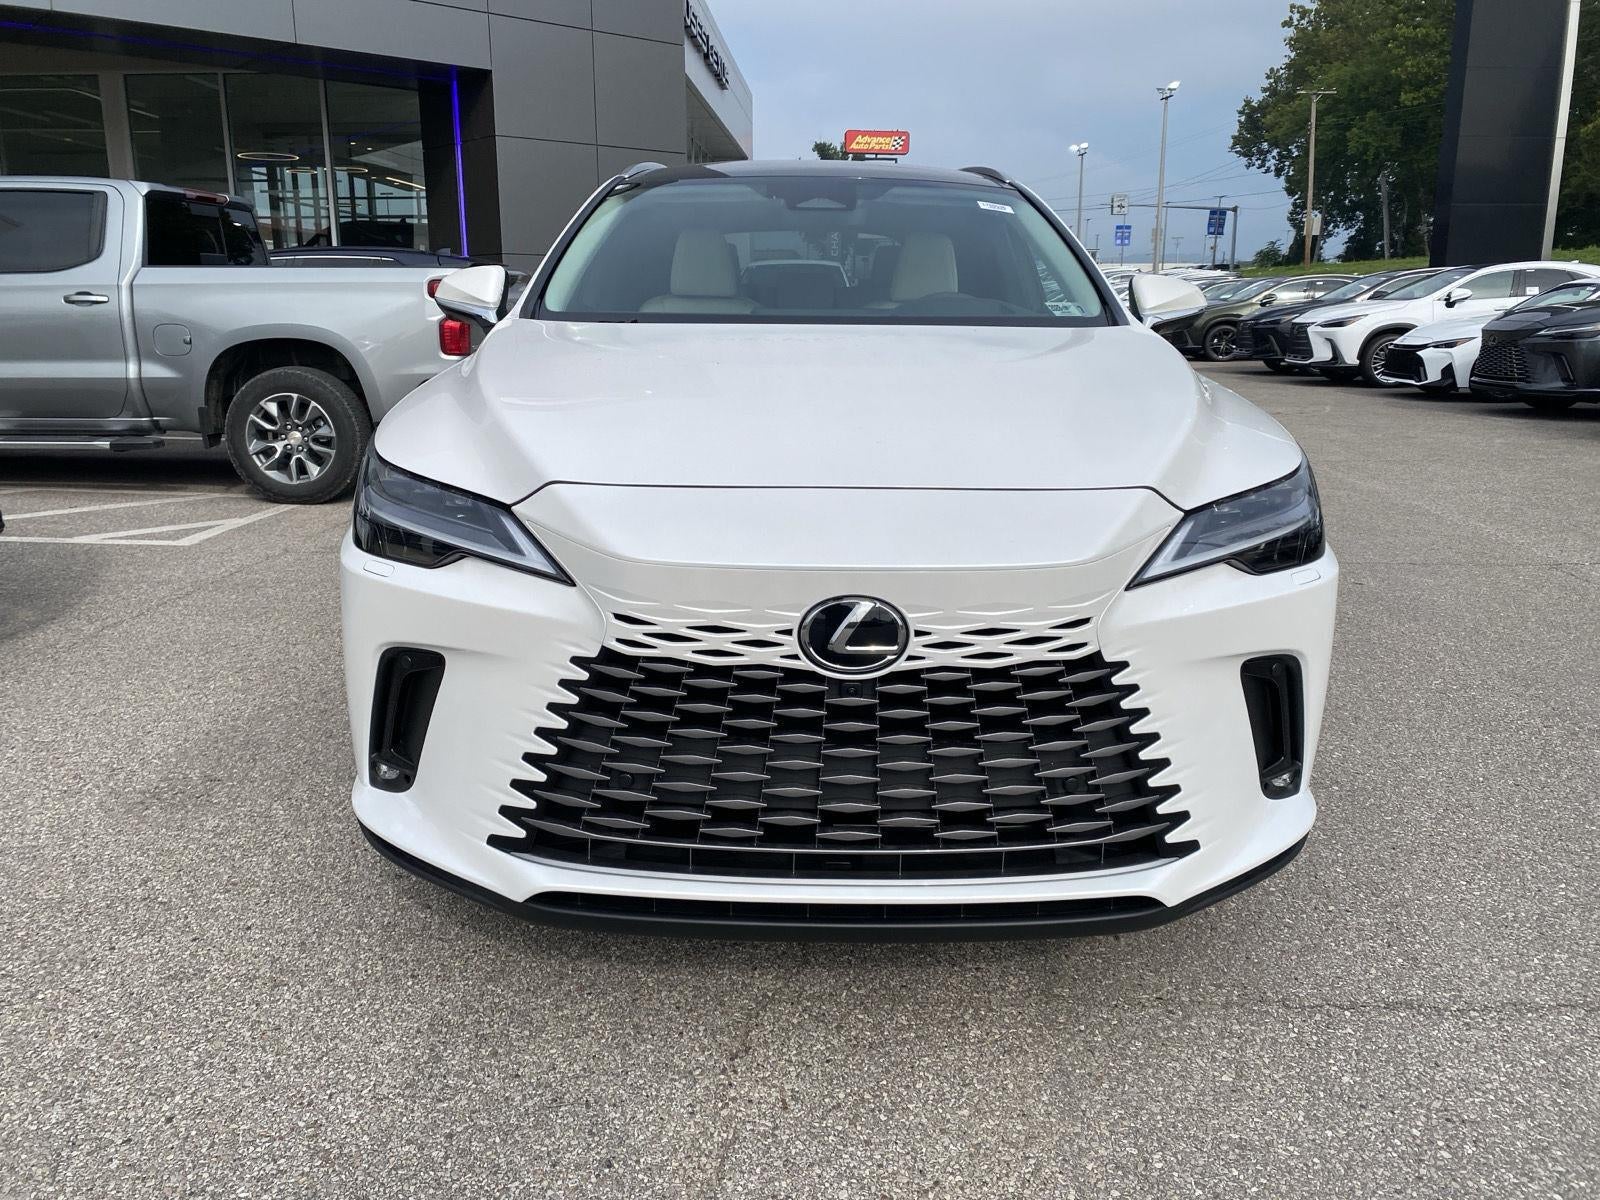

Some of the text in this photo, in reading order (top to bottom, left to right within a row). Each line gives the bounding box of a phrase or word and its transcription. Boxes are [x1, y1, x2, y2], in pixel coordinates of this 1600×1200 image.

[854, 134, 892, 144] Advance
[849, 141, 890, 150] Auto Parts
